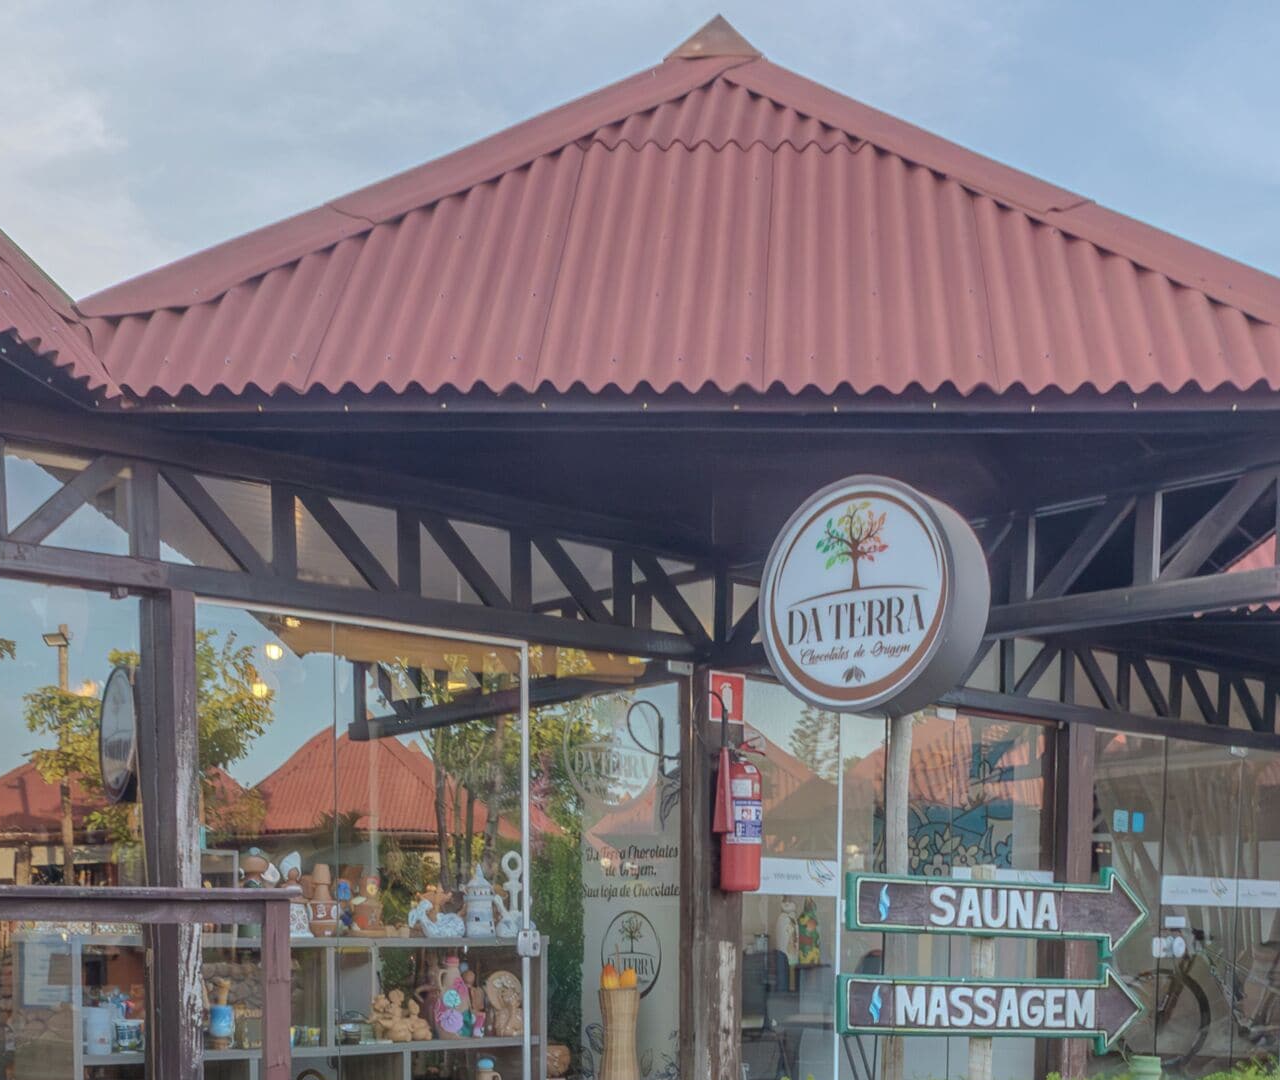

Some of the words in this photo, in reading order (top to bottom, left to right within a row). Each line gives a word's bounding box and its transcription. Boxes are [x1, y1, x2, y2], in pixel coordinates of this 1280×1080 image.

[788, 607, 823, 646] DA
[829, 594, 925, 640] TERRA
[800, 644, 849, 665] Chocolates
[853, 643, 865, 658] de
[871, 639, 911, 657] Origem
[929, 886, 1059, 931] SAUNA
[894, 984, 1096, 1029] MASSAGEM
